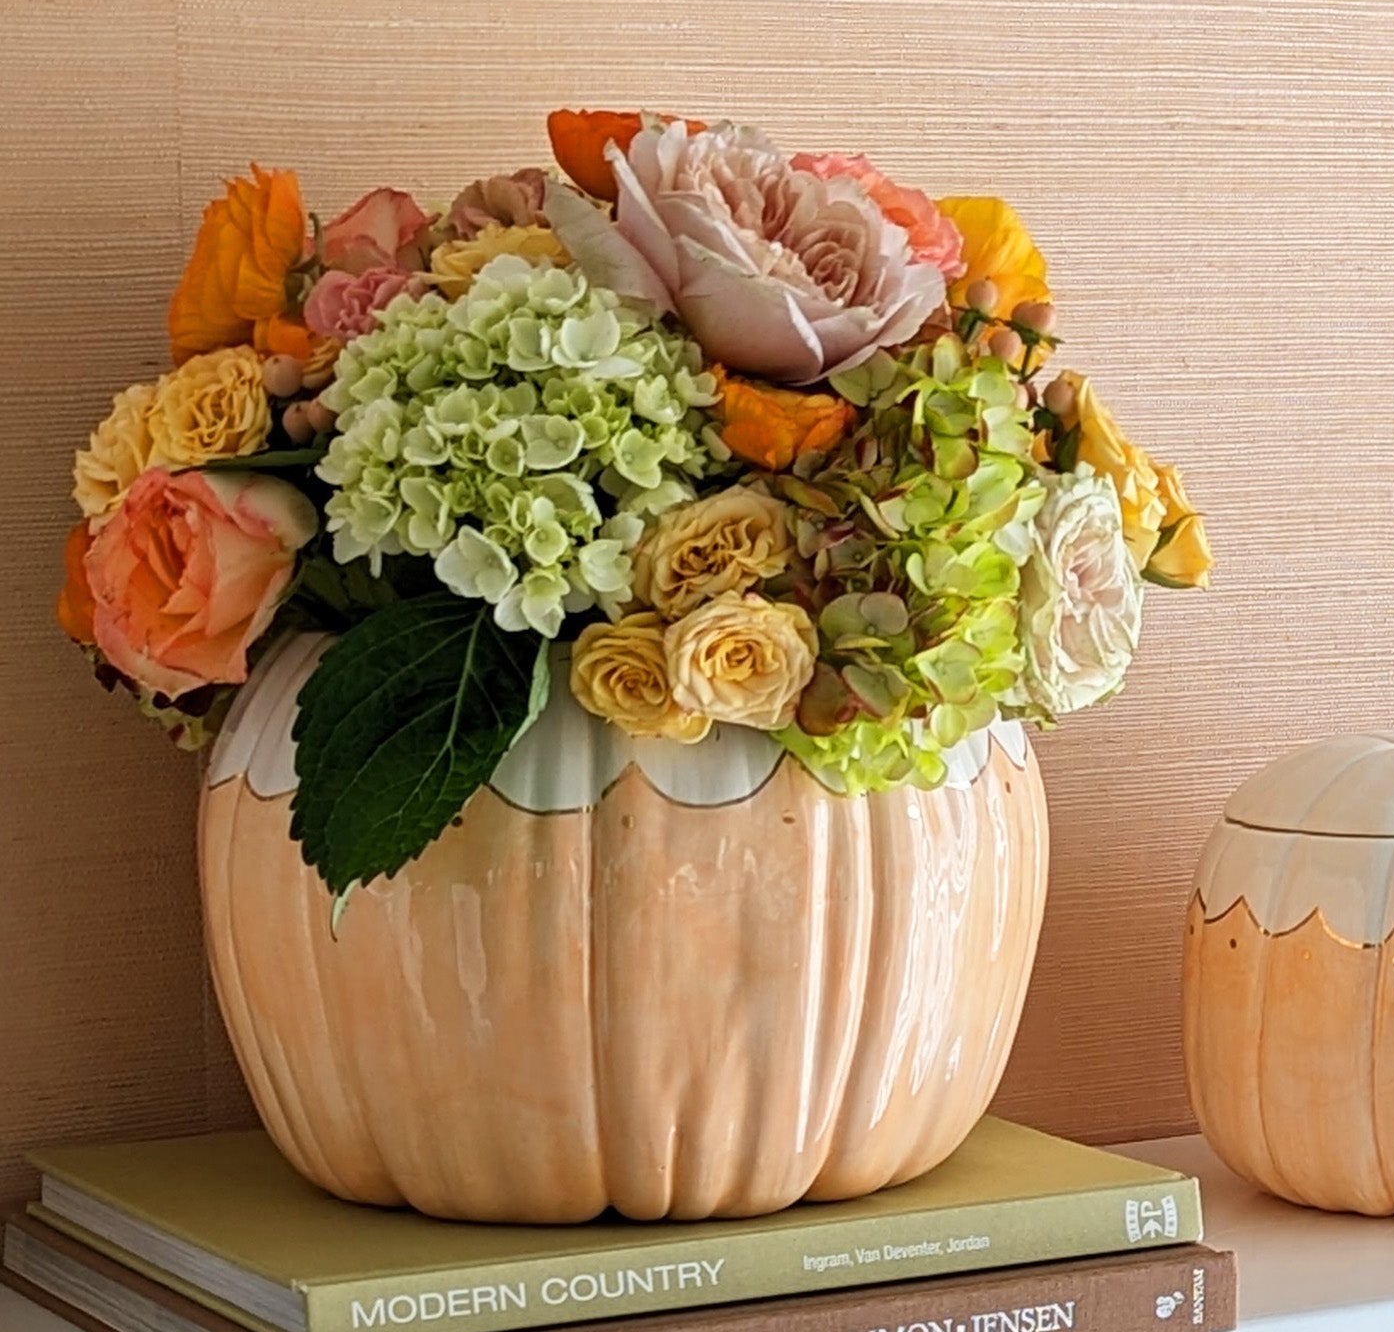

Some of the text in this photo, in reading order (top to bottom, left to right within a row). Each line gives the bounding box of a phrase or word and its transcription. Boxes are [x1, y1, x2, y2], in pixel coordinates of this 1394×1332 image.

[803, 1252, 854, 1272] Ingram,
[855, 1247, 880, 1264] Van
[946, 1234, 990, 1254] Jordan
[351, 1258, 725, 1329] MODERN COUNTRY
